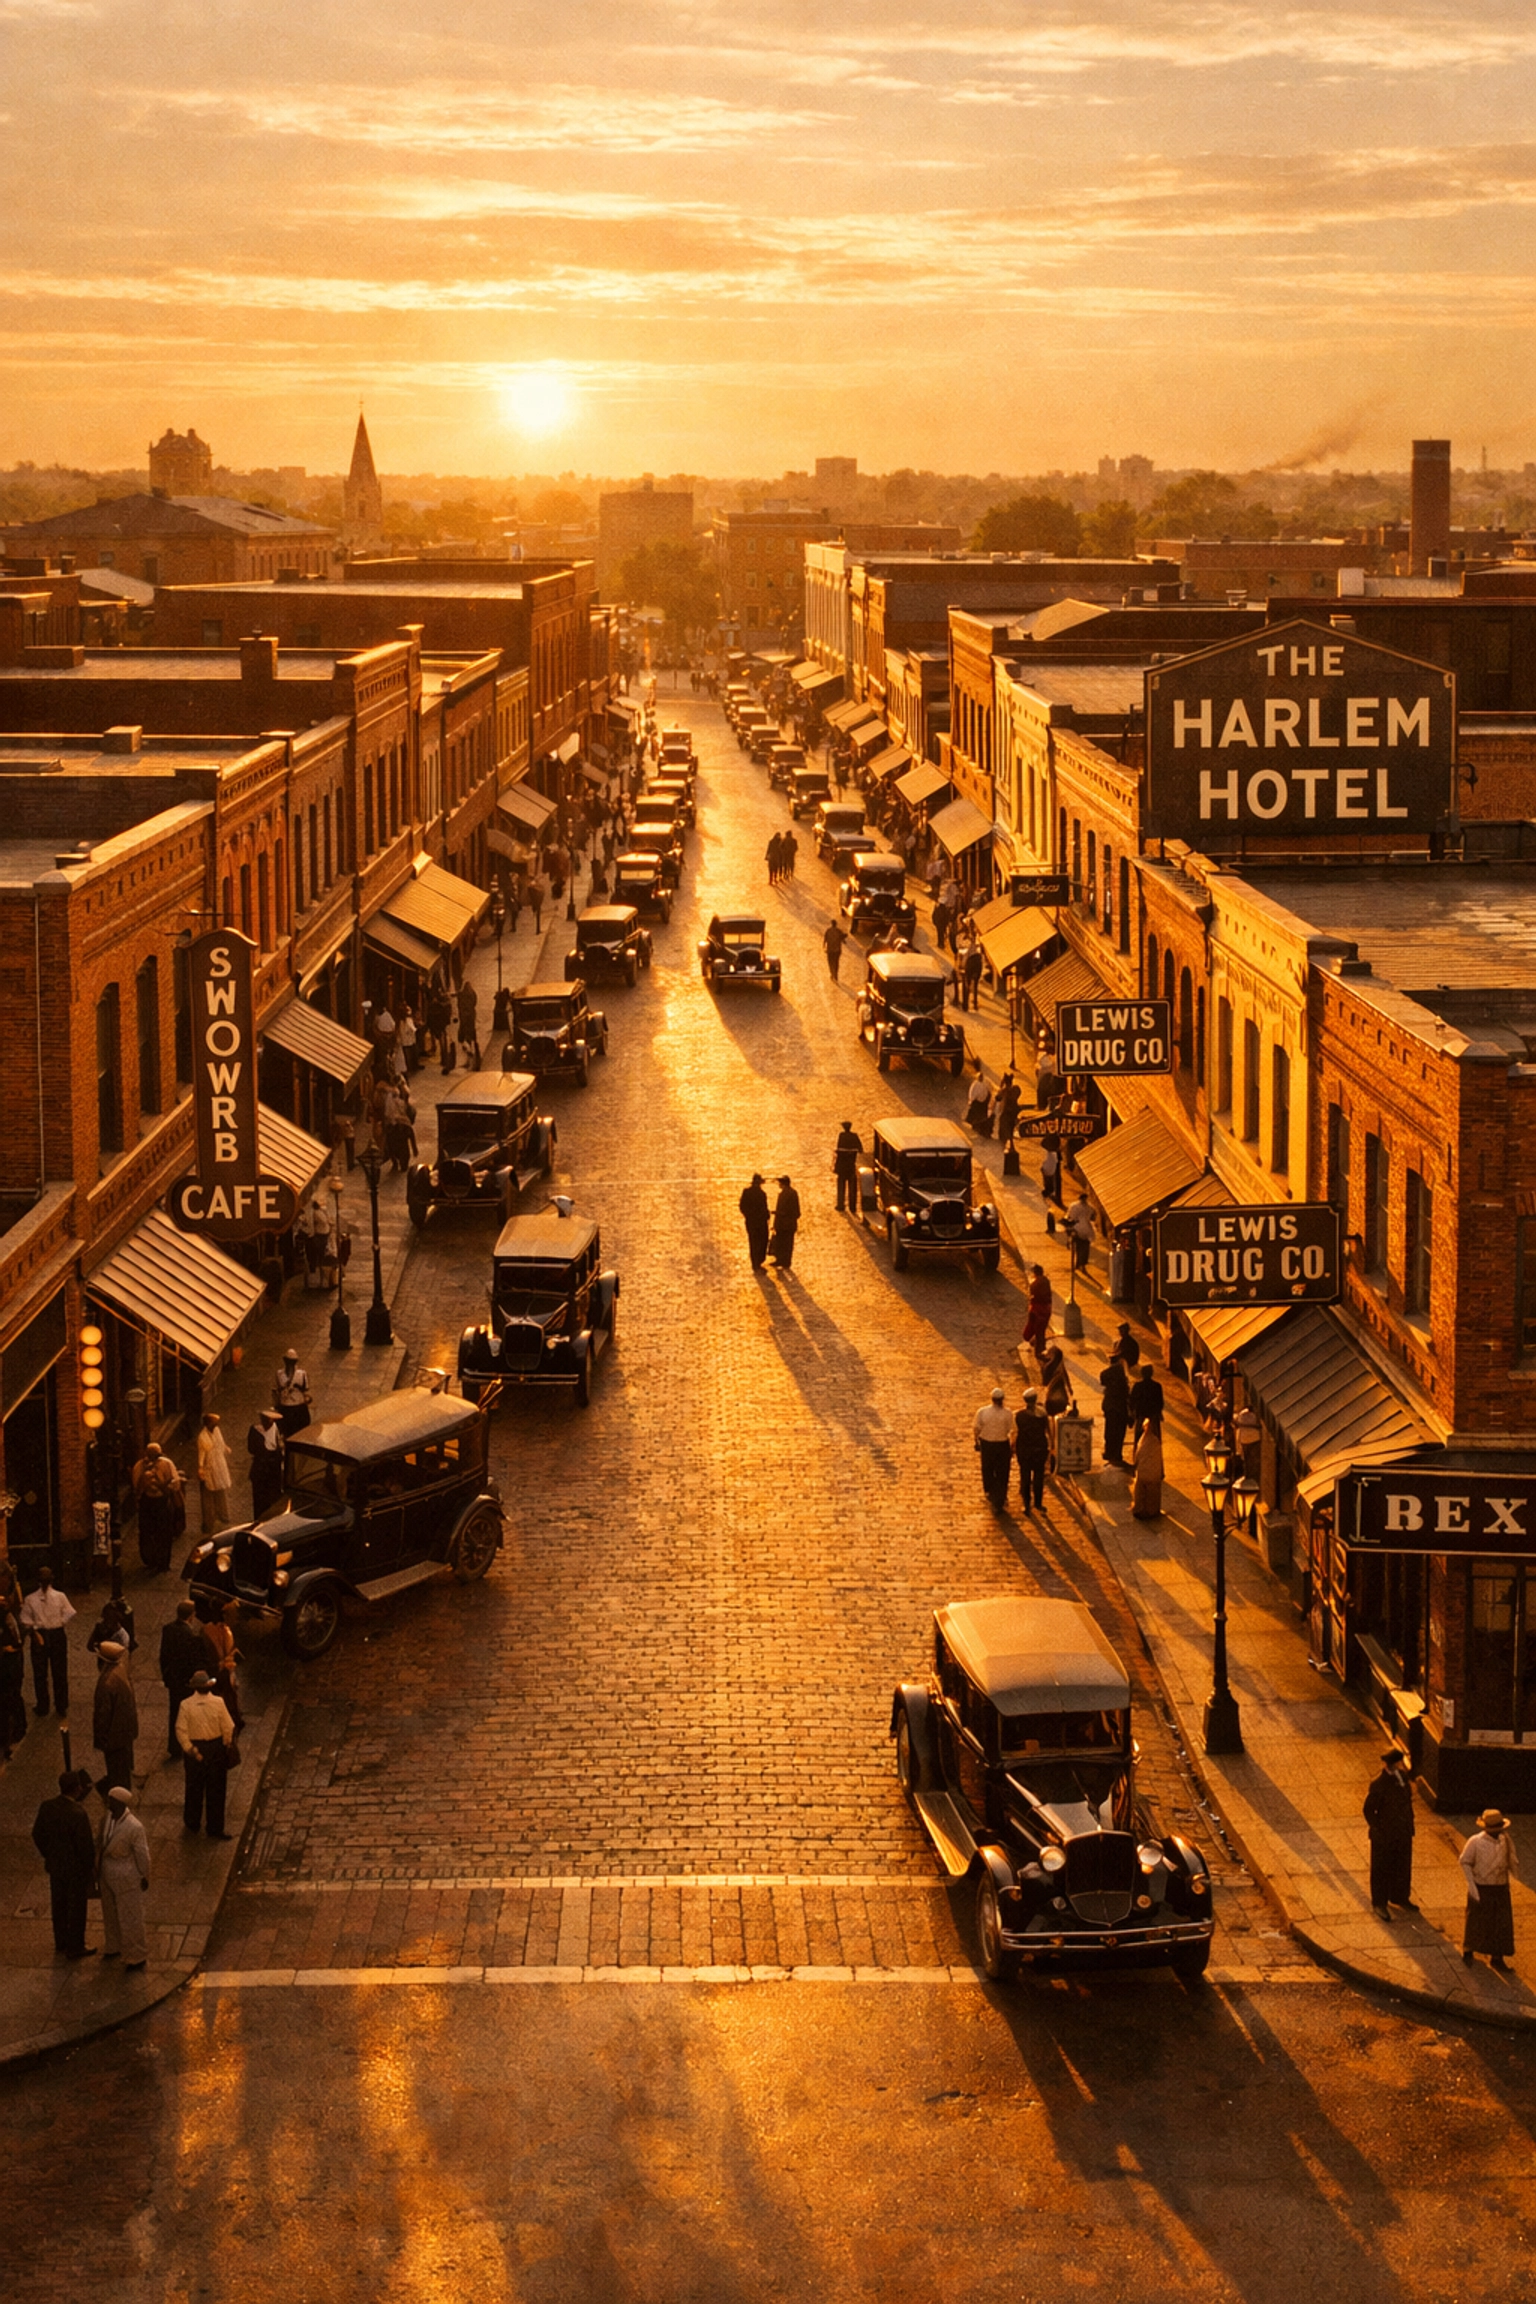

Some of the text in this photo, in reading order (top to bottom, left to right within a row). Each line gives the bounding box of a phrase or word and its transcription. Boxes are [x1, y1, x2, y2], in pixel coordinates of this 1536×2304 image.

[1257, 645, 1345, 676] THE
[1173, 698, 1430, 749] HARLEM
[1200, 769, 1408, 819] HOTEL
[1075, 1007, 1155, 1032] LEWIS
[1064, 1039, 1126, 1067] DRUG
[182, 1185, 281, 1220] CAFE
[1198, 1215, 1298, 1243] LEWIS
[1165, 1245, 1331, 1284] DRUG CO.
